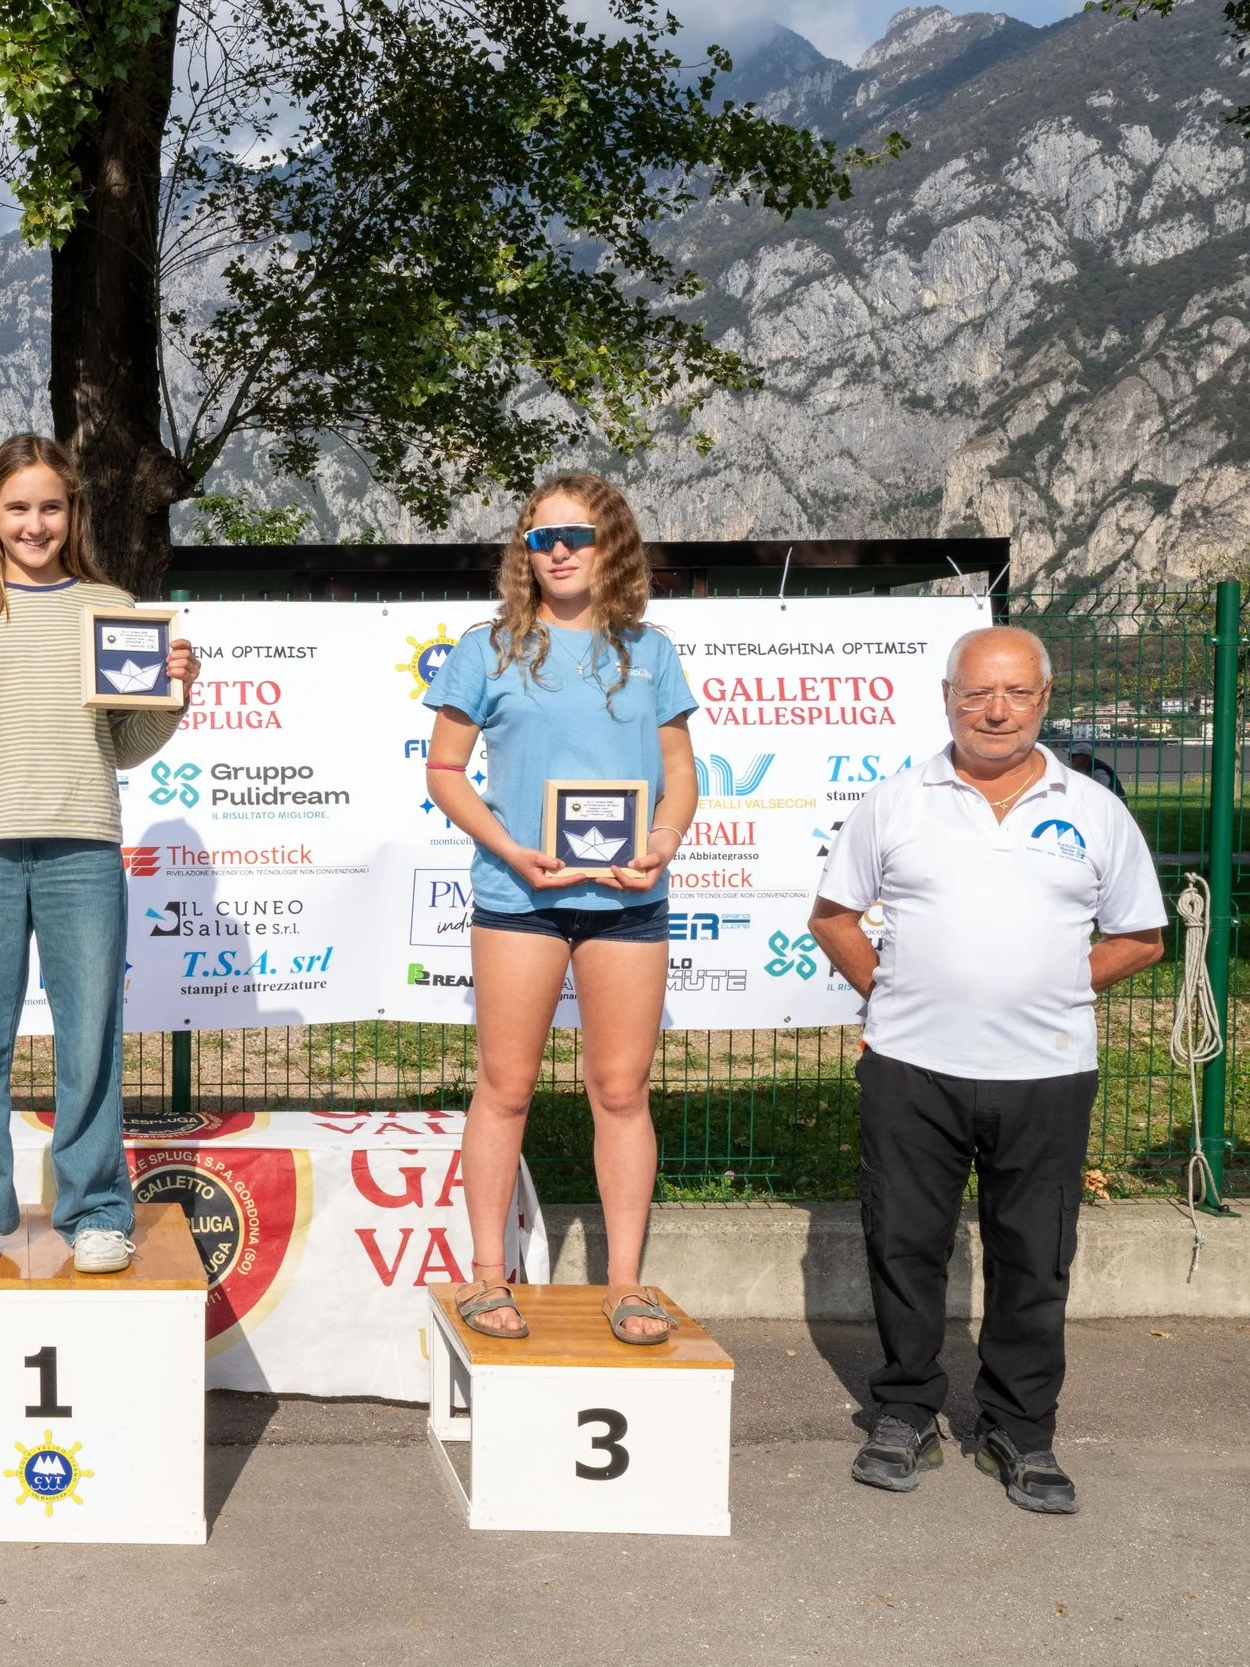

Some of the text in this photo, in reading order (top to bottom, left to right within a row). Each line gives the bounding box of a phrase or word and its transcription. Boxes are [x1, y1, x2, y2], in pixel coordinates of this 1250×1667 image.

[232, 646, 317, 659] OPTIMIST
[704, 642, 835, 656] INTERLAGHINA
[842, 641, 928, 655] OPTIMIST
[702, 676, 894, 702] GALLETTO
[704, 706, 897, 726] VALLESPLUGA
[210, 762, 314, 786] Gruppo
[211, 786, 350, 806] Pulidream
[698, 798, 817, 809] ETALLI VALSECCHI
[212, 810, 330, 820] IL RISULTATO MIGLIORE.
[166, 844, 313, 865] Thermostick
[689, 851, 759, 861] Abbiategrasso
[166, 869, 210, 877] RIVELAZIONE
[256, 868, 298, 876] TECNOLOGIE
[316, 867, 370, 875] CONVENZIONALI
[182, 900, 304, 916] IL CUNEO
[182, 919, 300, 937] Salute S.r.l.
[182, 946, 334, 978] T.S.A. srl
[180, 979, 327, 997] stampi e attrezzature
[148, 1150, 201, 1165] SPLUGA
[204, 1155, 234, 1183] S.P.A.
[137, 1175, 215, 1204] GALLETTO
[234, 1181, 260, 1246] GORDONA
[238, 1247, 257, 1276] (SO)
[24, 1346, 73, 1418] 1
[575, 1407, 630, 1481] 3
[34, 1476, 63, 1485] CVT
